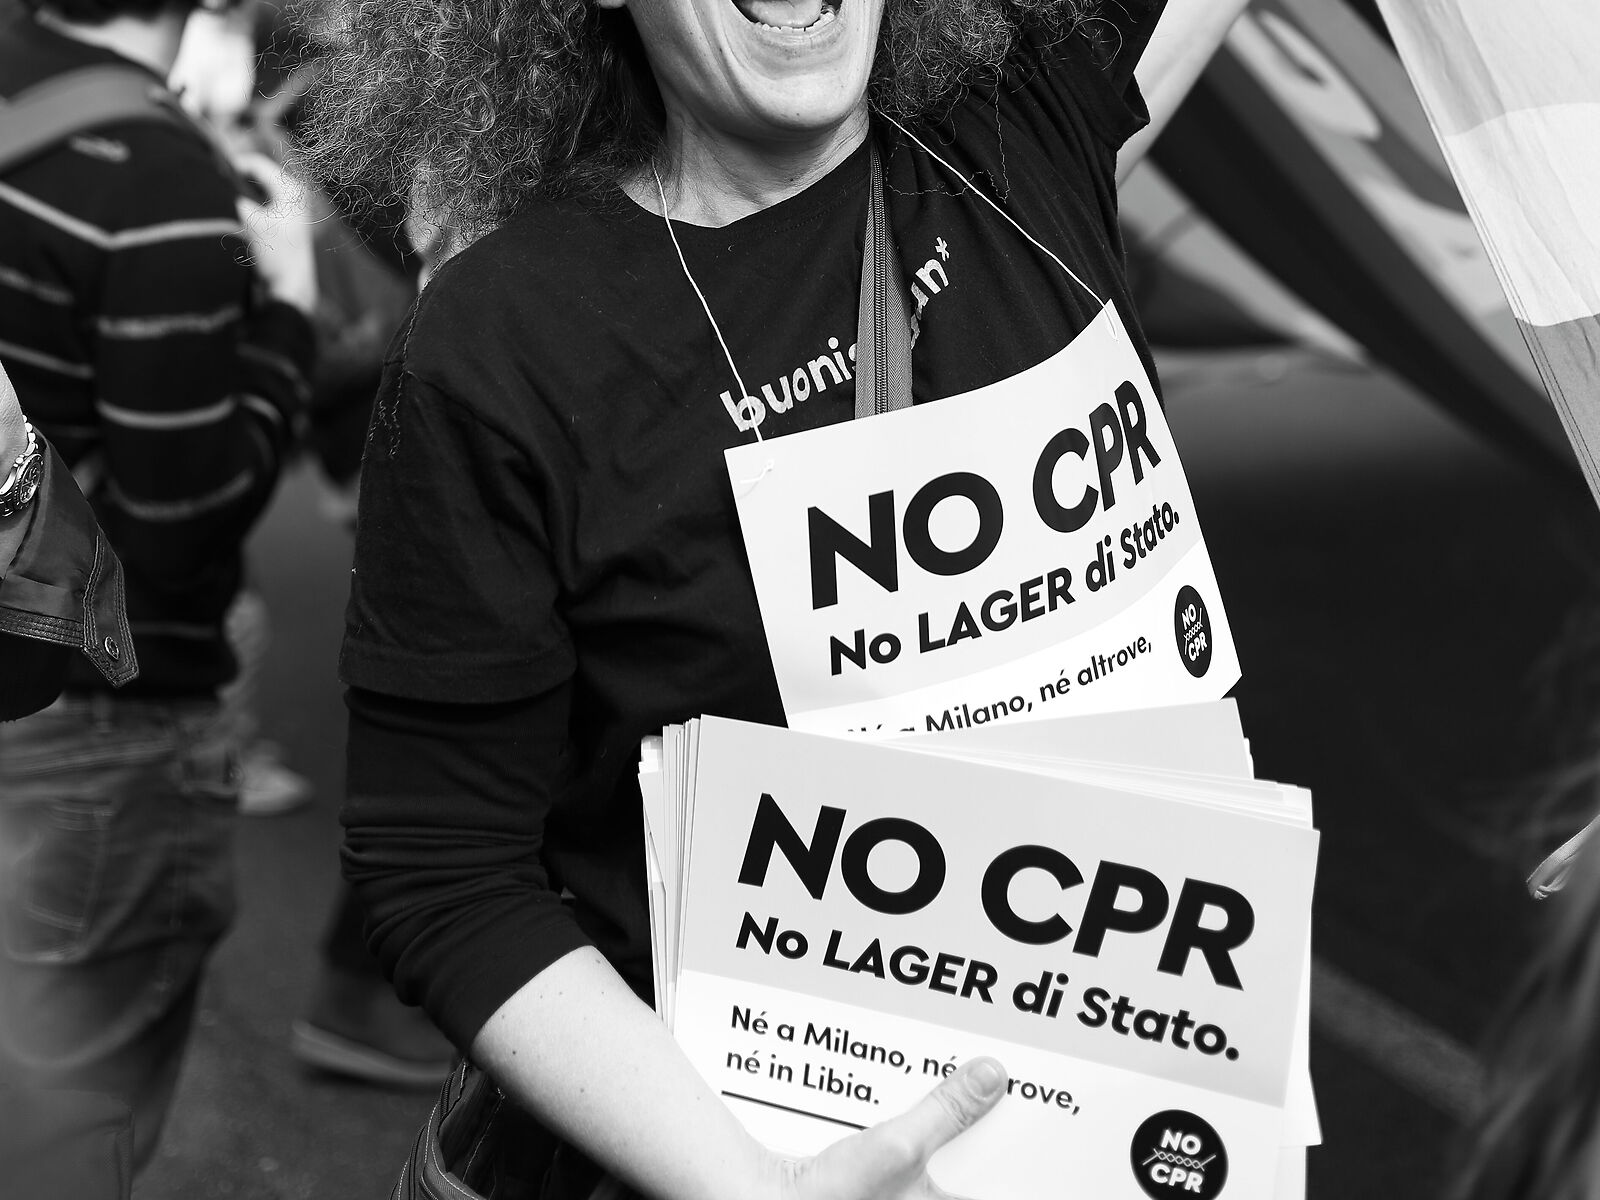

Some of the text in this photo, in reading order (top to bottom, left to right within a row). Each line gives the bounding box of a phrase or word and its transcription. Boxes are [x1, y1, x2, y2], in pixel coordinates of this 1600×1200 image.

[808, 381, 1161, 610] NO CPR
[830, 502, 1179, 676] No LAGER di Stato.
[1181, 603, 1197, 631] NO
[1188, 631, 1208, 661] CPR
[926, 635, 1152, 732] Milano, né altrove,
[738, 793, 1254, 990] NO CPR
[736, 912, 1239, 1060] No LAGER di Stato.
[726, 1051, 880, 1104] né in Libia.
[731, 1005, 768, 1034] Né
[777, 1025, 794, 1042] a
[804, 1022, 912, 1074] Milano,
[922, 1055, 957, 1079] né
[1151, 1163, 1203, 1193] CPR
[1161, 1129, 1201, 1155] NO
